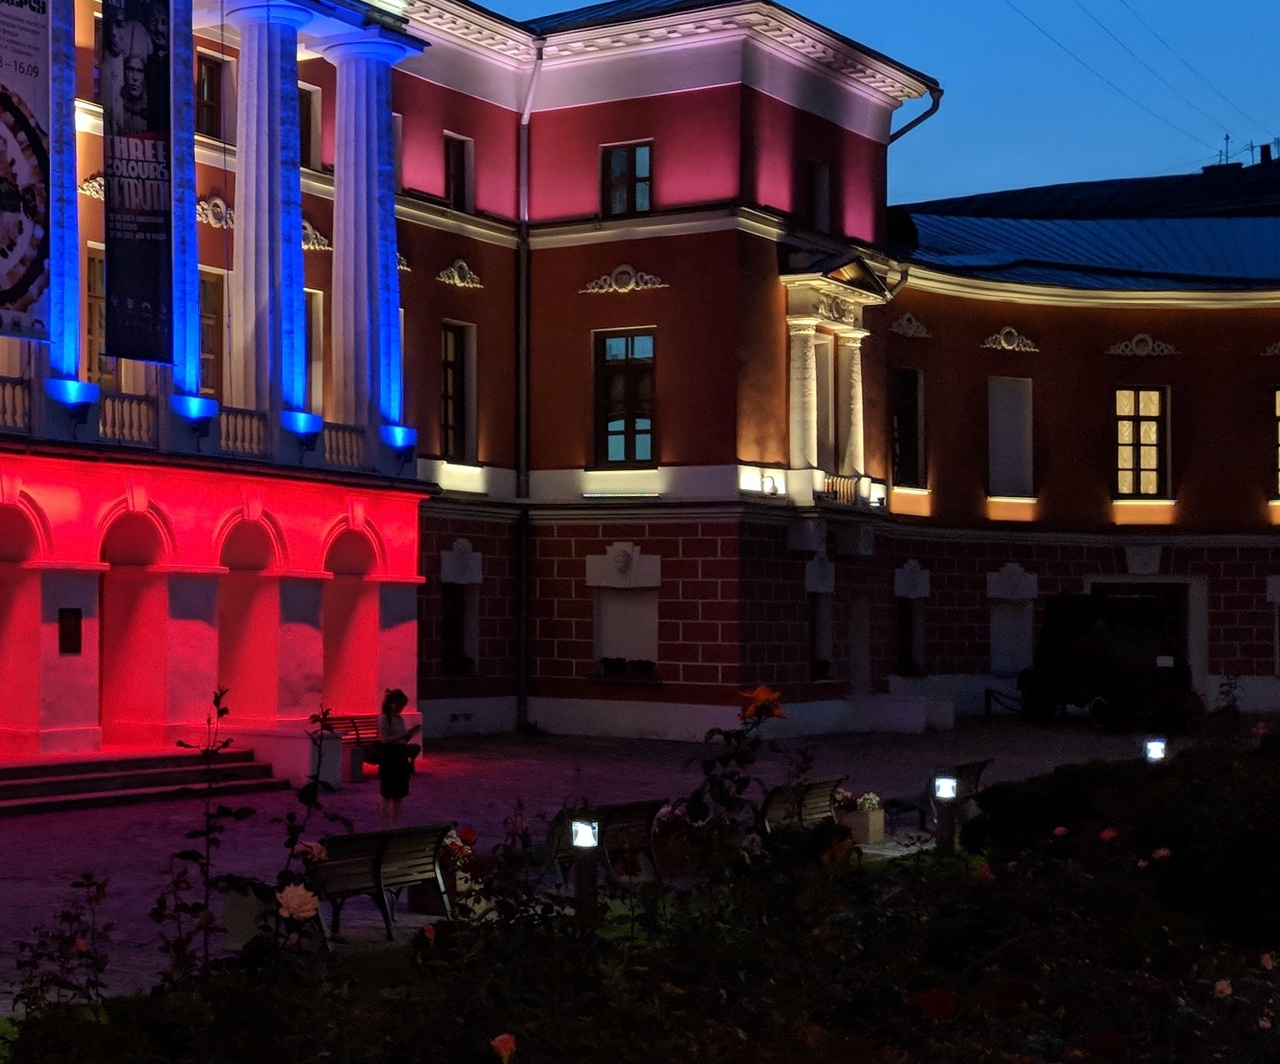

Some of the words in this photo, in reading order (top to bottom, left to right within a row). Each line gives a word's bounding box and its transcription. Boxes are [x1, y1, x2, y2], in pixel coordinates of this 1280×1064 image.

[14, 60, 39, 78] 16.09
[105, 134, 167, 164] THREE
[105, 157, 169, 180] COLOURS
